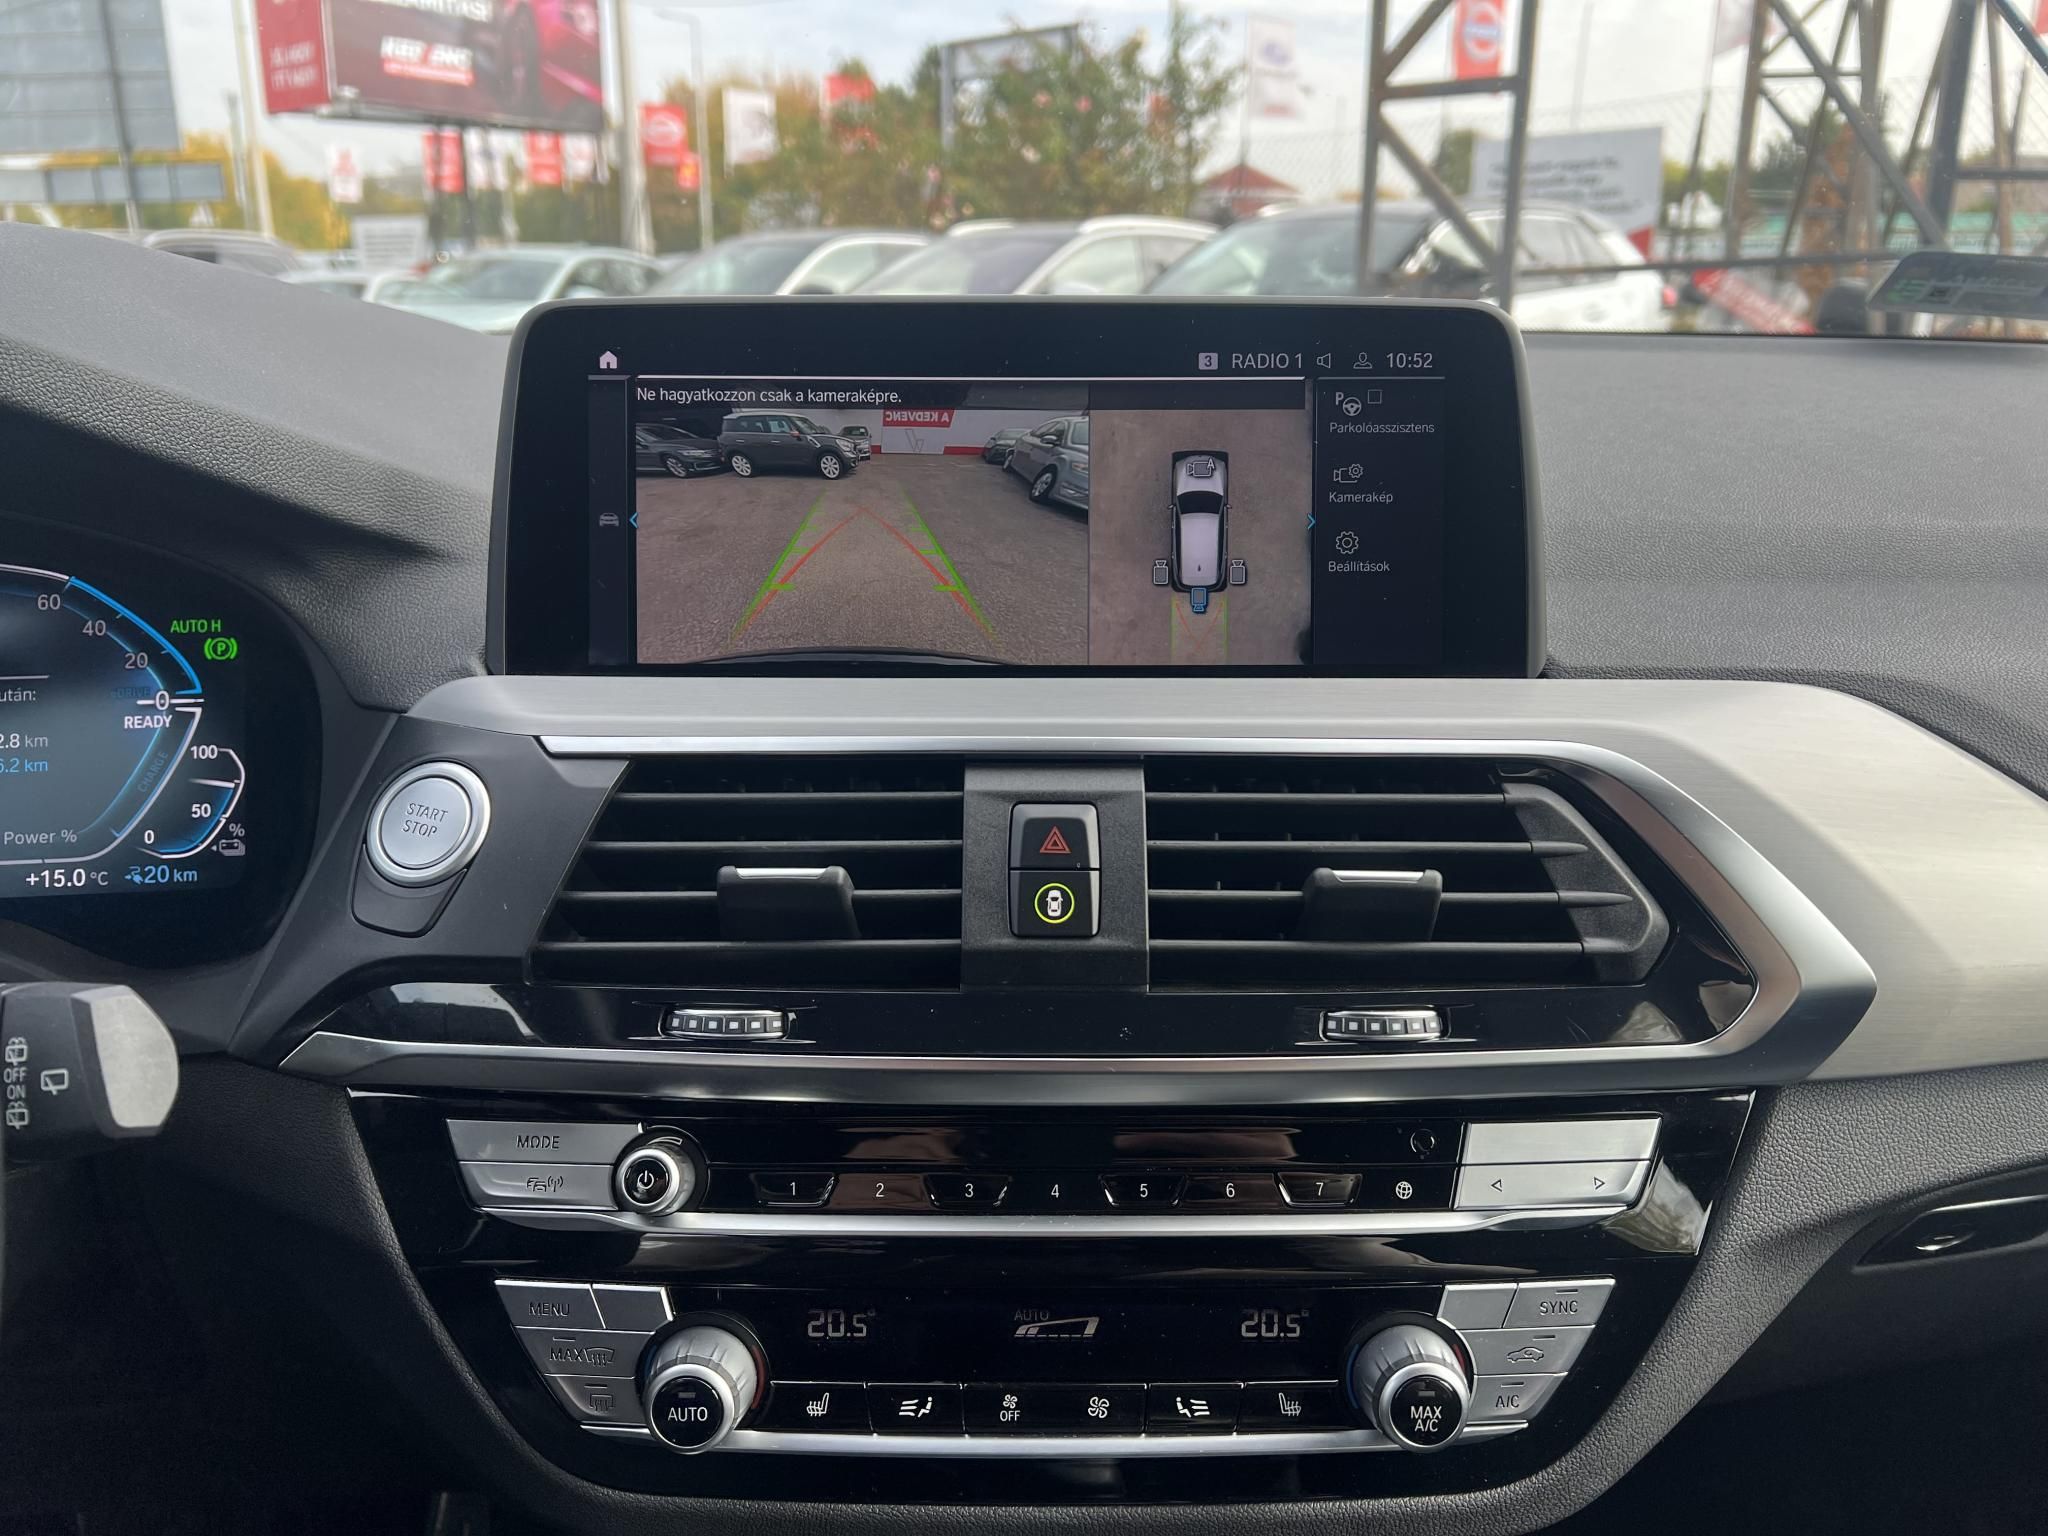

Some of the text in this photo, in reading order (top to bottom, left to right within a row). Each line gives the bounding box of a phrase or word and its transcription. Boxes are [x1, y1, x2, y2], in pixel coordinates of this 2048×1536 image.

[1232, 353, 1289, 369] RADIO
[1295, 353, 1302, 369] 1
[1386, 353, 1433, 368] 10:52
[637, 388, 902, 405] Ne hagyatkozzon csak a kameraképre.
[1329, 422, 1435, 433] Parkolóasszisztens
[1329, 491, 1394, 504] Kamerakép
[1328, 560, 1390, 572] Beállítások
[37, 594, 60, 610] 60
[82, 620, 106, 636] 40
[170, 619, 221, 633] AUTO H
[124, 653, 148, 669] 20
[155, 690, 169, 710] 0
[124, 715, 173, 729] READY
[25, 735, 48, 748] km
[190, 745, 218, 759] 100
[25, 759, 48, 772] km
[137, 750, 169, 792] CHARGE
[191, 803, 212, 818] 50
[406, 802, 449, 822] START
[229, 823, 245, 836] %
[402, 819, 438, 837] STOP
[4, 829, 77, 845] Power %
[144, 830, 154, 844] 0
[25, 868, 109, 888] +15.0 °C
[144, 865, 198, 884] 20 km
[3, 1067, 27, 1083] OFF
[7, 1085, 26, 1099] ON
[516, 1135, 560, 1149] MODE
[789, 1182, 796, 1196] 1
[875, 1183, 885, 1198] 2
[964, 1183, 974, 1198] 3
[1050, 1184, 1060, 1198] 4
[1139, 1183, 1149, 1198] 5
[1225, 1183, 1236, 1198] 6
[1315, 1182, 1325, 1196] 7
[529, 1303, 570, 1316] MENU
[1014, 1309, 1050, 1321] AUTO
[1539, 1301, 1579, 1315] SYNC
[549, 1348, 583, 1362] MAX
[1495, 1395, 1520, 1408] A/C
[667, 1407, 708, 1422] AUTO
[1000, 1410, 1021, 1421] OFF
[1410, 1405, 1443, 1419] MAX
[1415, 1419, 1439, 1433] A/C
